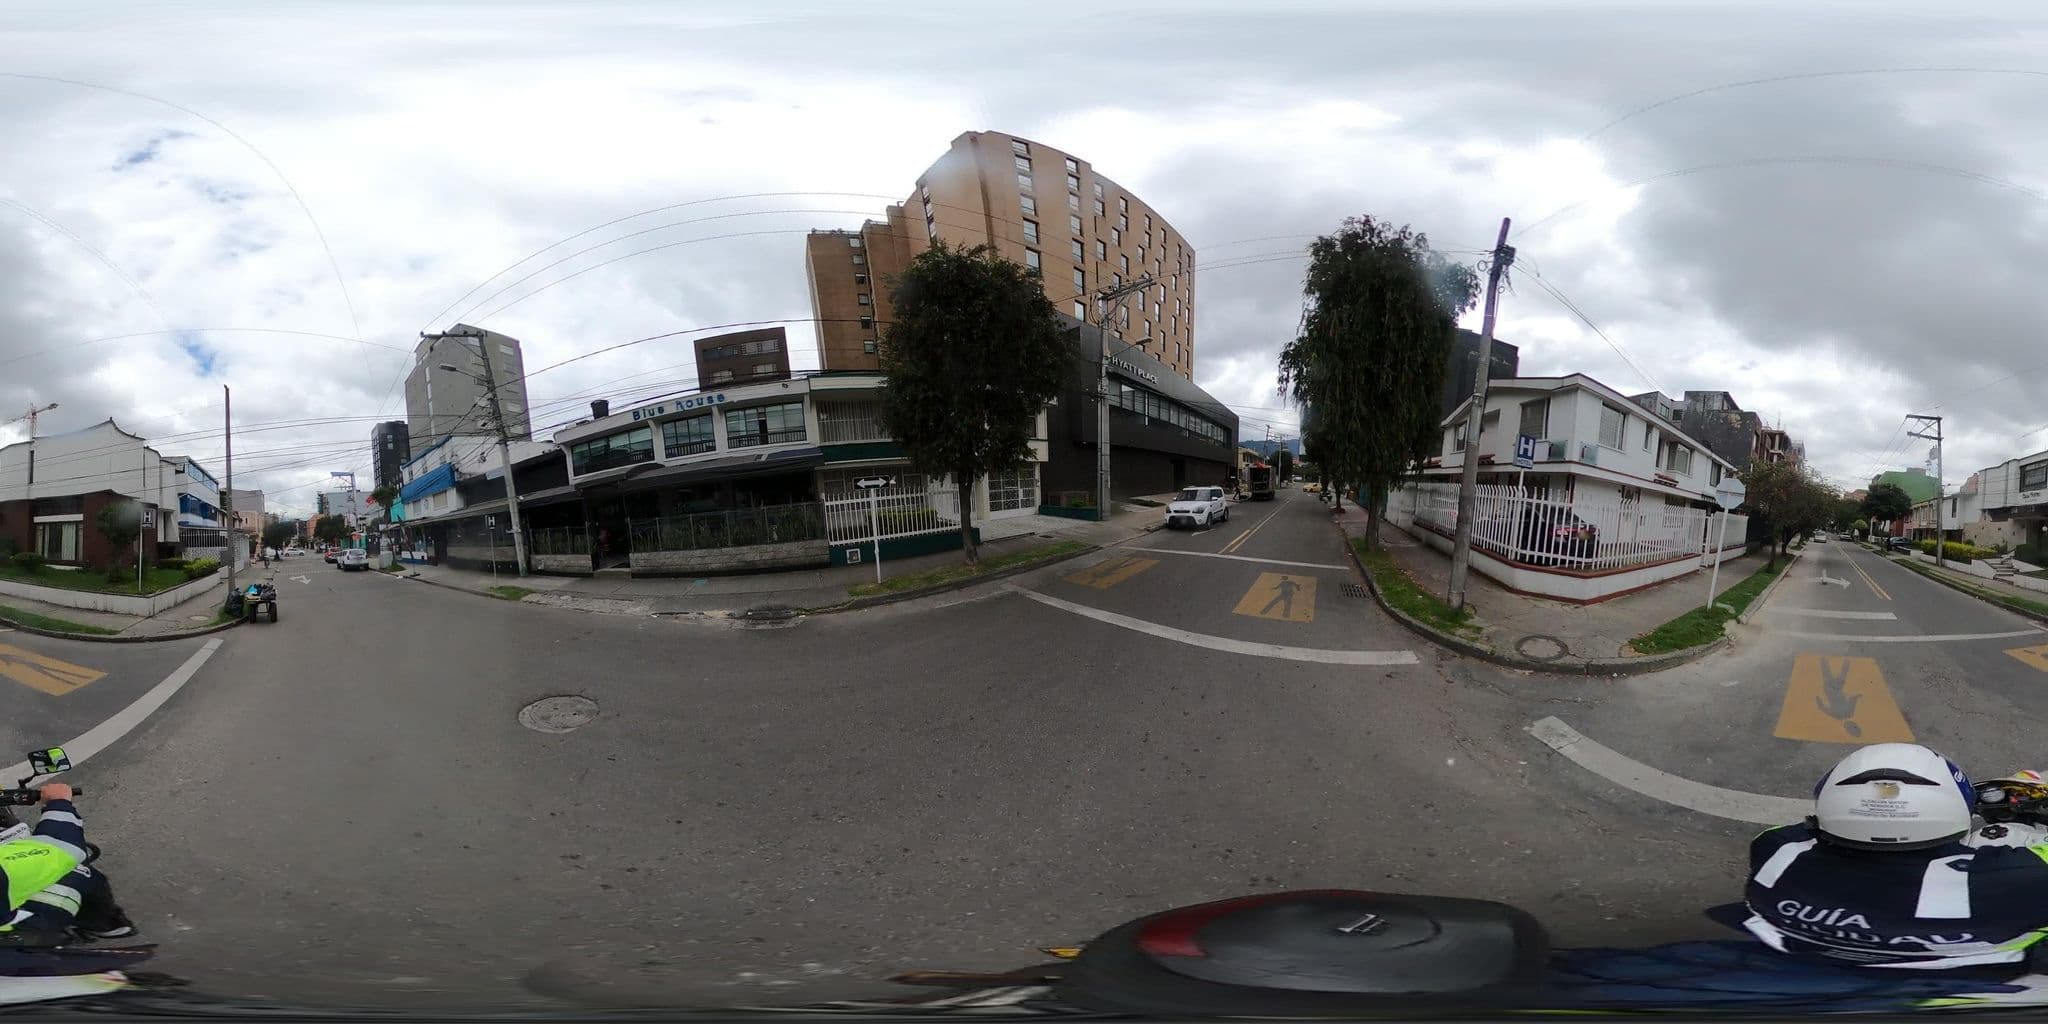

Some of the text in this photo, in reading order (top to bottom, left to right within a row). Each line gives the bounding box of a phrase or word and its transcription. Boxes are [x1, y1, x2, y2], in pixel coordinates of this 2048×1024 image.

[1112, 356, 1159, 385] HYATT PLACE
[632, 406, 665, 421] Blue
[1519, 436, 1535, 457] H
[143, 511, 152, 522] H
[487, 516, 496, 527] H
[1776, 899, 1871, 929] GUÍA
